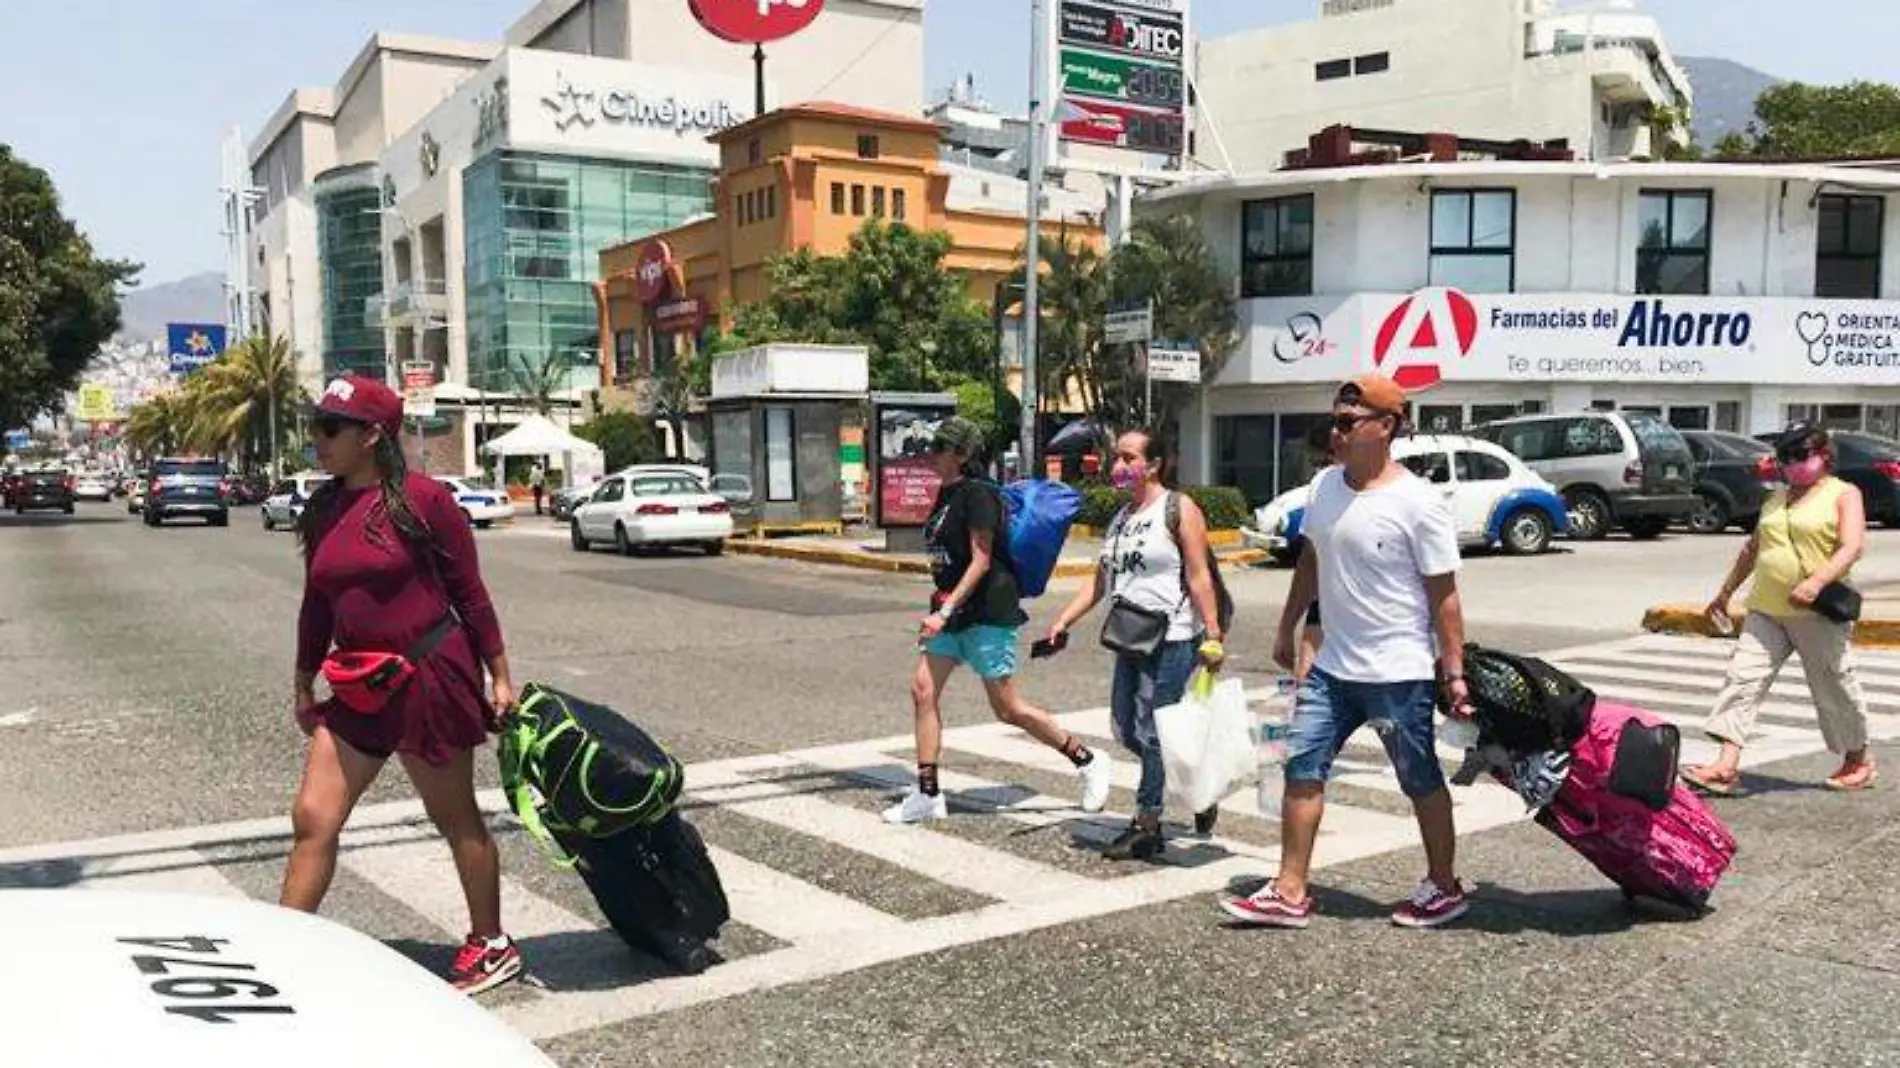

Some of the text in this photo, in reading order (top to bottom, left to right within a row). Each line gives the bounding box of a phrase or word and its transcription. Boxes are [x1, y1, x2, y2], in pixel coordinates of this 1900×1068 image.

[1490, 299, 1752, 347] Farmacias del Ahorro
[1303, 338, 1326, 357] 24
[1508, 355, 1530, 373] Te
[116, 935, 297, 1024] 1974
